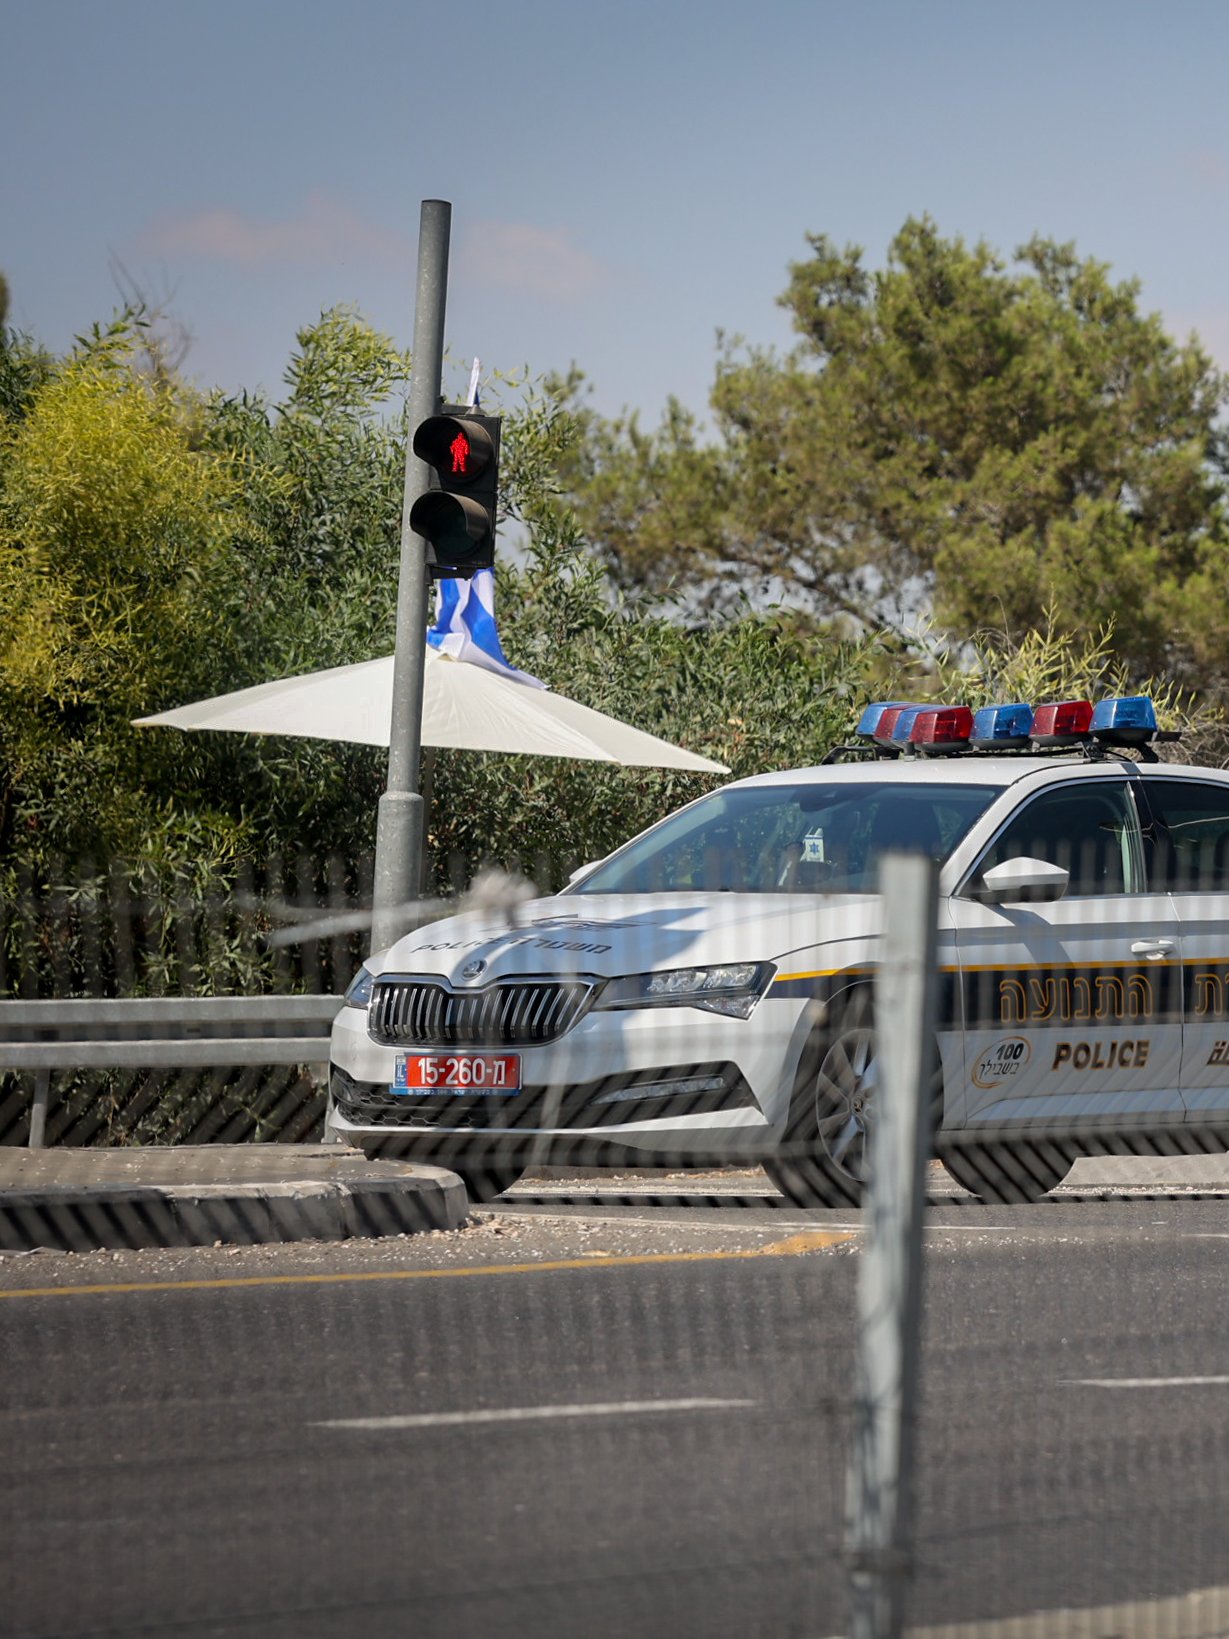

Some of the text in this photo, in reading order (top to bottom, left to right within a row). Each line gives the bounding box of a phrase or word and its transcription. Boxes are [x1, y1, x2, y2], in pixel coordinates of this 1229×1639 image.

[410, 936, 505, 953] POLICE
[999, 973, 1153, 1024] התנועה
[996, 1042, 1025, 1062] 100
[1051, 1039, 1150, 1072] POLICE
[979, 1060, 1020, 1080] בשבילך
